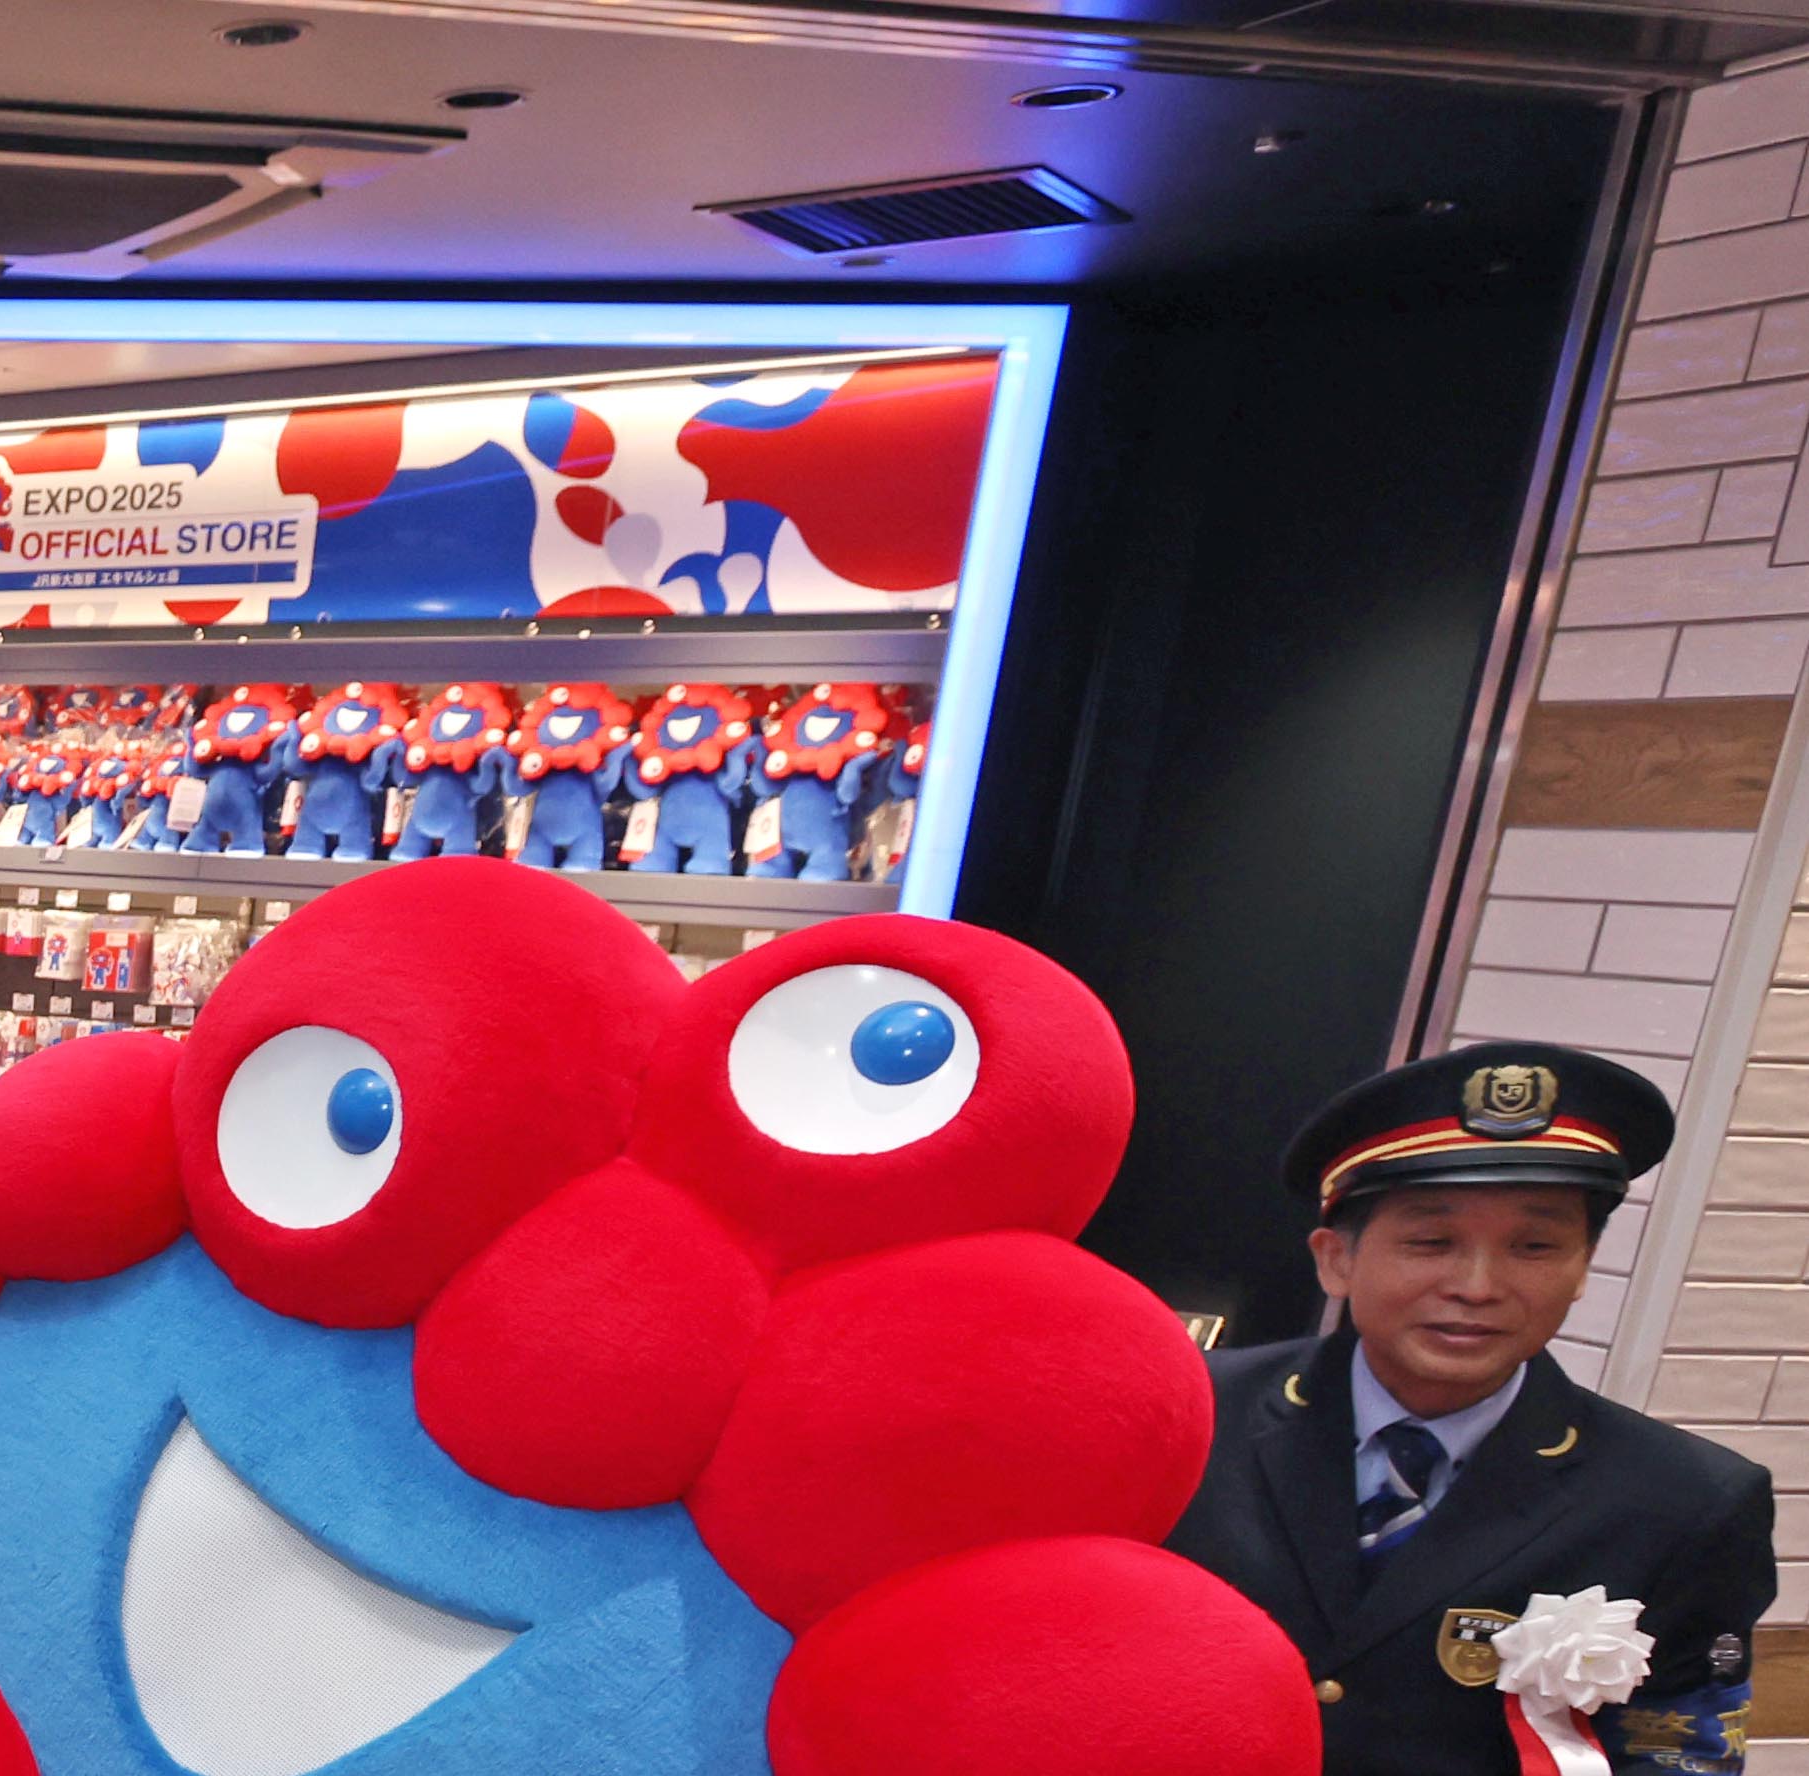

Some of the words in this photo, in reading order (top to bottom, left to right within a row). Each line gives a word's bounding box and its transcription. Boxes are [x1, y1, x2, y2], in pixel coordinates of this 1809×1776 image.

[23, 481, 183, 516] EXPO2025
[20, 526, 169, 560] OFFICIAL
[176, 520, 299, 554] STORE
